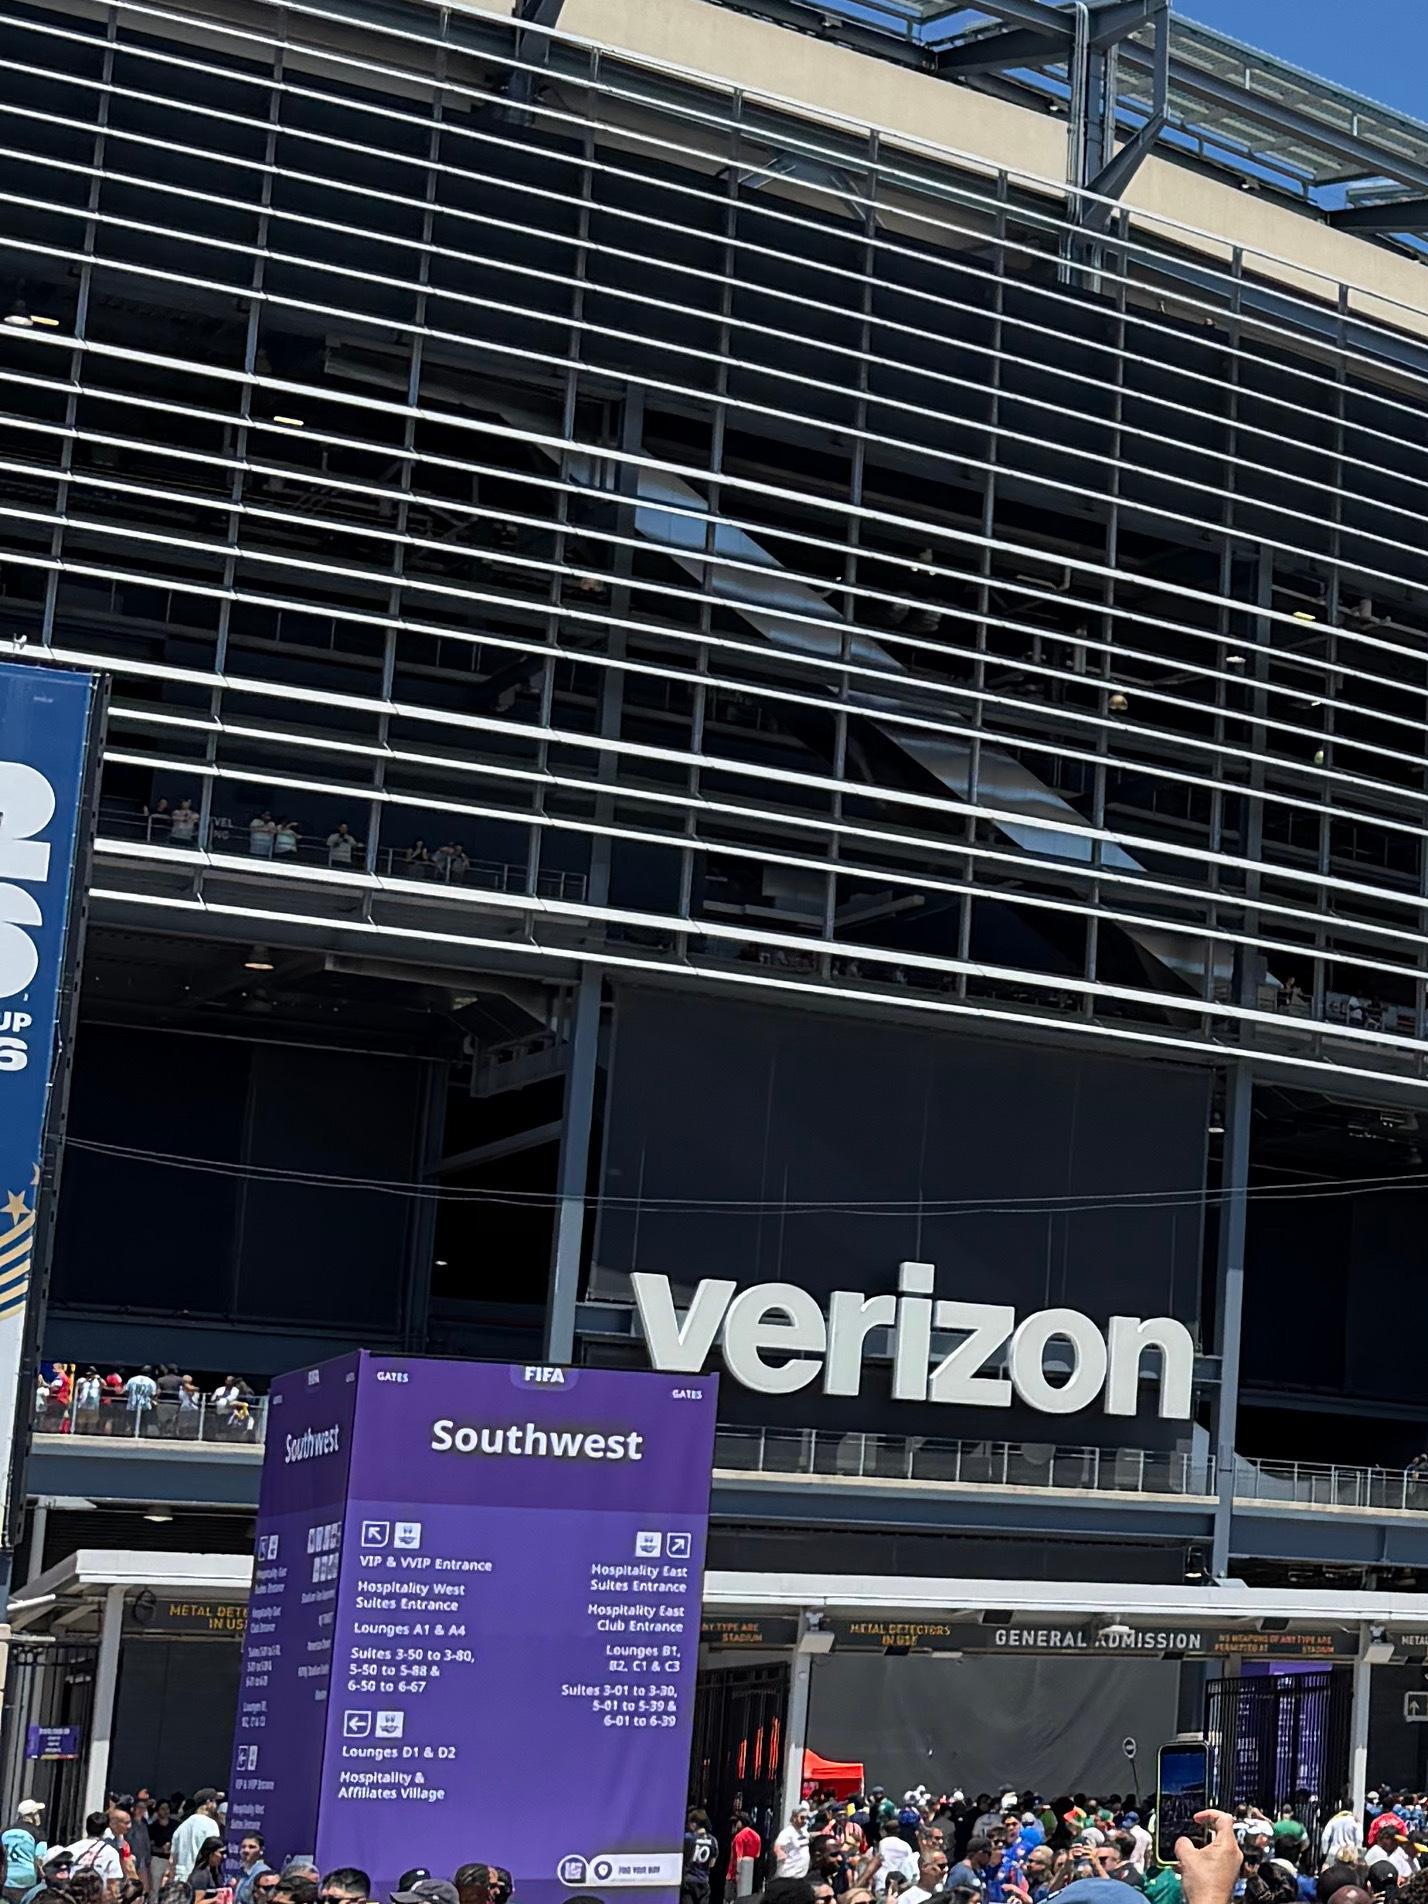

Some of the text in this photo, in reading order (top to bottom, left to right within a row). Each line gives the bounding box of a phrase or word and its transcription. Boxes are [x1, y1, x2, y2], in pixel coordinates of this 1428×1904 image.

[629, 1261, 1193, 1419] verizon
[377, 1372, 409, 1383] GATES
[524, 1366, 565, 1383] FIFA
[672, 1389, 703, 1399] GATES
[284, 1423, 340, 1464] Southwest
[431, 1419, 643, 1460] Southwest
[360, 1556, 492, 1571] VIP & VVIP Entrance
[592, 1564, 687, 1579] Hospitality East
[358, 1581, 465, 1596] Hospitality West
[591, 1580, 686, 1592] Suites Entrance
[170, 1604, 212, 1617] METAL
[356, 1597, 458, 1611] Suites Entrance
[588, 1604, 684, 1618] Hospitality East
[208, 1618, 224, 1630] IN
[227, 1620, 248, 1631] US
[355, 1624, 465, 1637] Lounges A1 & A4
[597, 1620, 683, 1632] Club Entrance
[995, 1629, 1201, 1649] GENERAL ADMISSION
[1402, 1635, 1428, 1646] METAL
[351, 1648, 391, 1659] Suites
[428, 1650, 440, 1659] to
[607, 1645, 658, 1658] Lounges
[382, 1665, 395, 1675] to
[430, 1667, 440, 1676] &
[652, 1662, 660, 1671] &
[380, 1681, 393, 1692] to
[562, 1685, 599, 1695] Suites
[634, 1686, 645, 1696] to
[623, 1701, 635, 1711] to
[634, 1716, 646, 1726] to
[343, 1747, 456, 1760] Lounges D1 & D2
[340, 1772, 424, 1786] Hospitality &
[338, 1787, 445, 1802] Affiliates Village
[692, 1844, 710, 1862] 10
